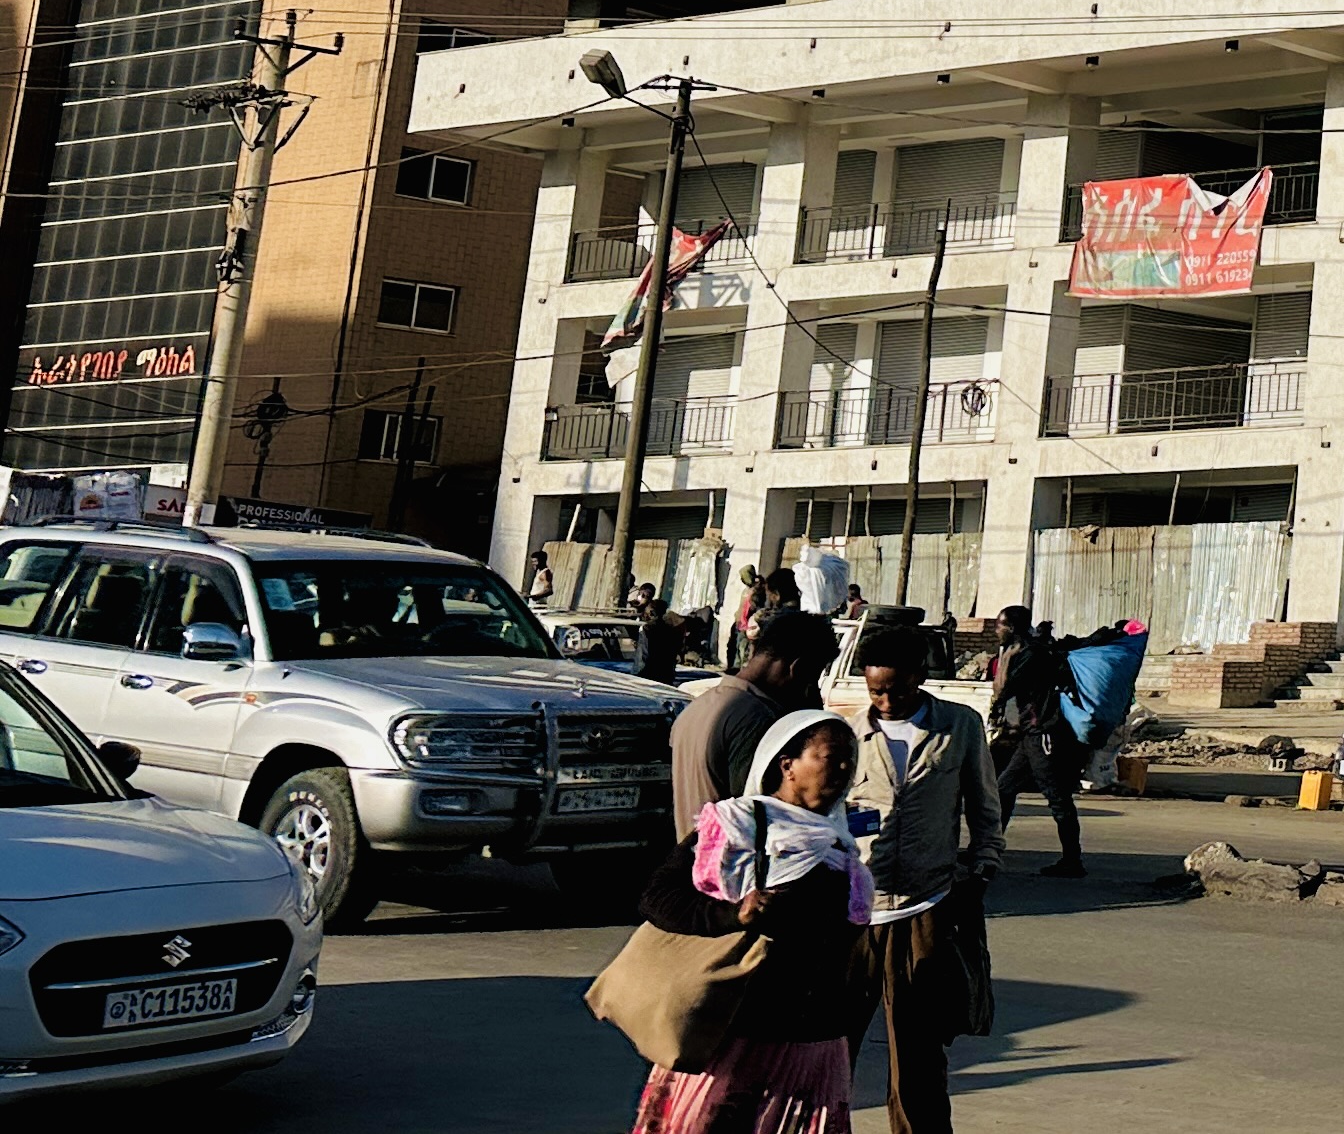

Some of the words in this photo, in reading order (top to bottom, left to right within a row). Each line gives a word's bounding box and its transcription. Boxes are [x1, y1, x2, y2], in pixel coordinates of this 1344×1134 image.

[1185, 271, 1212, 286] 0911
[236, 503, 325, 525] PROFESSIONAL
[141, 983, 223, 1019] C11538
